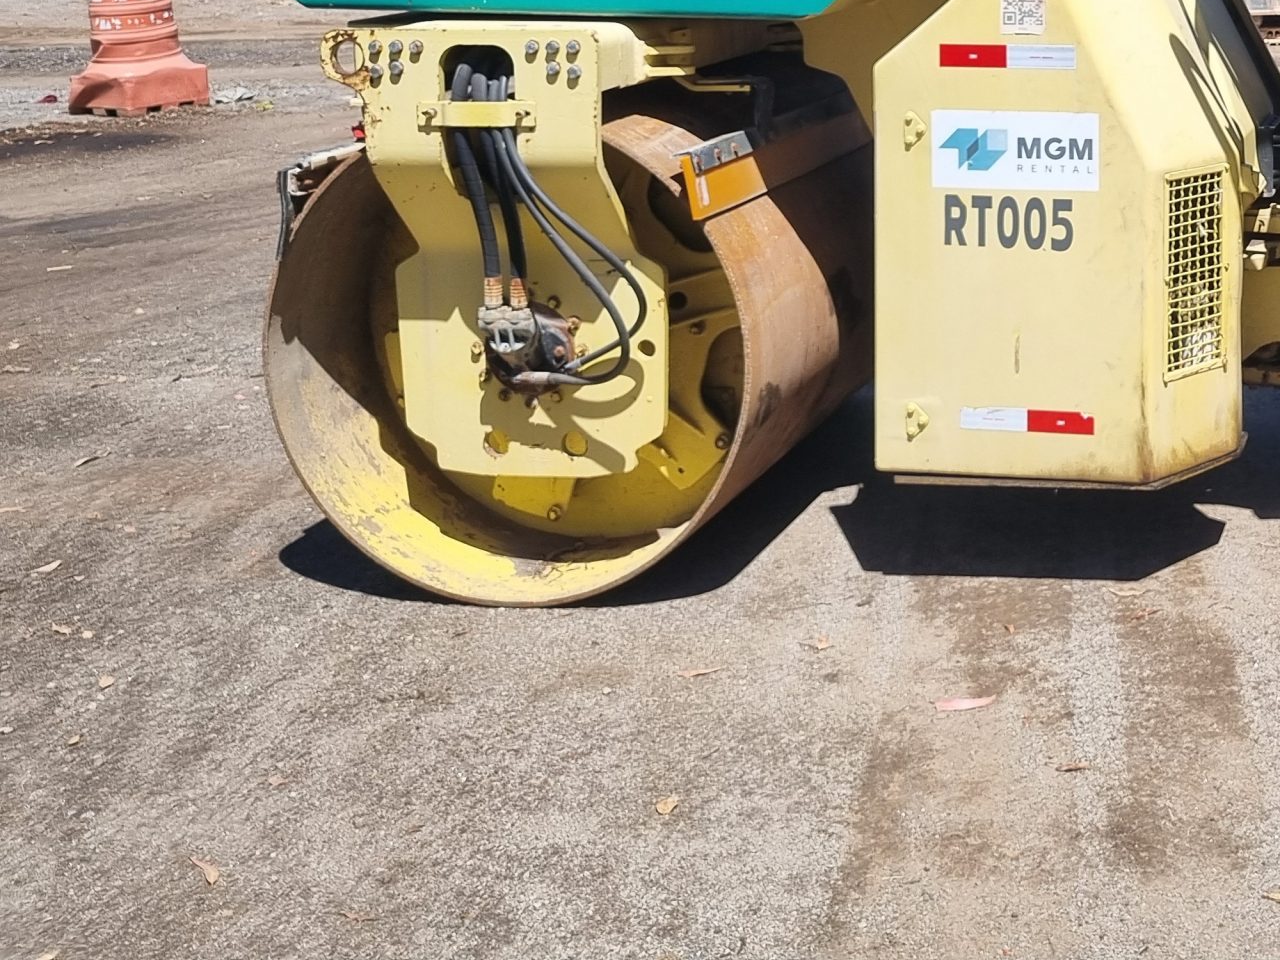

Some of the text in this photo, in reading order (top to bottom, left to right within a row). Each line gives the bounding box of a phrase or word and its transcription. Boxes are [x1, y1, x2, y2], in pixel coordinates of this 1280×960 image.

[1016, 136, 1094, 161] MGM
[1016, 164, 1094, 174] RENTAL
[944, 194, 1074, 252] RT005
